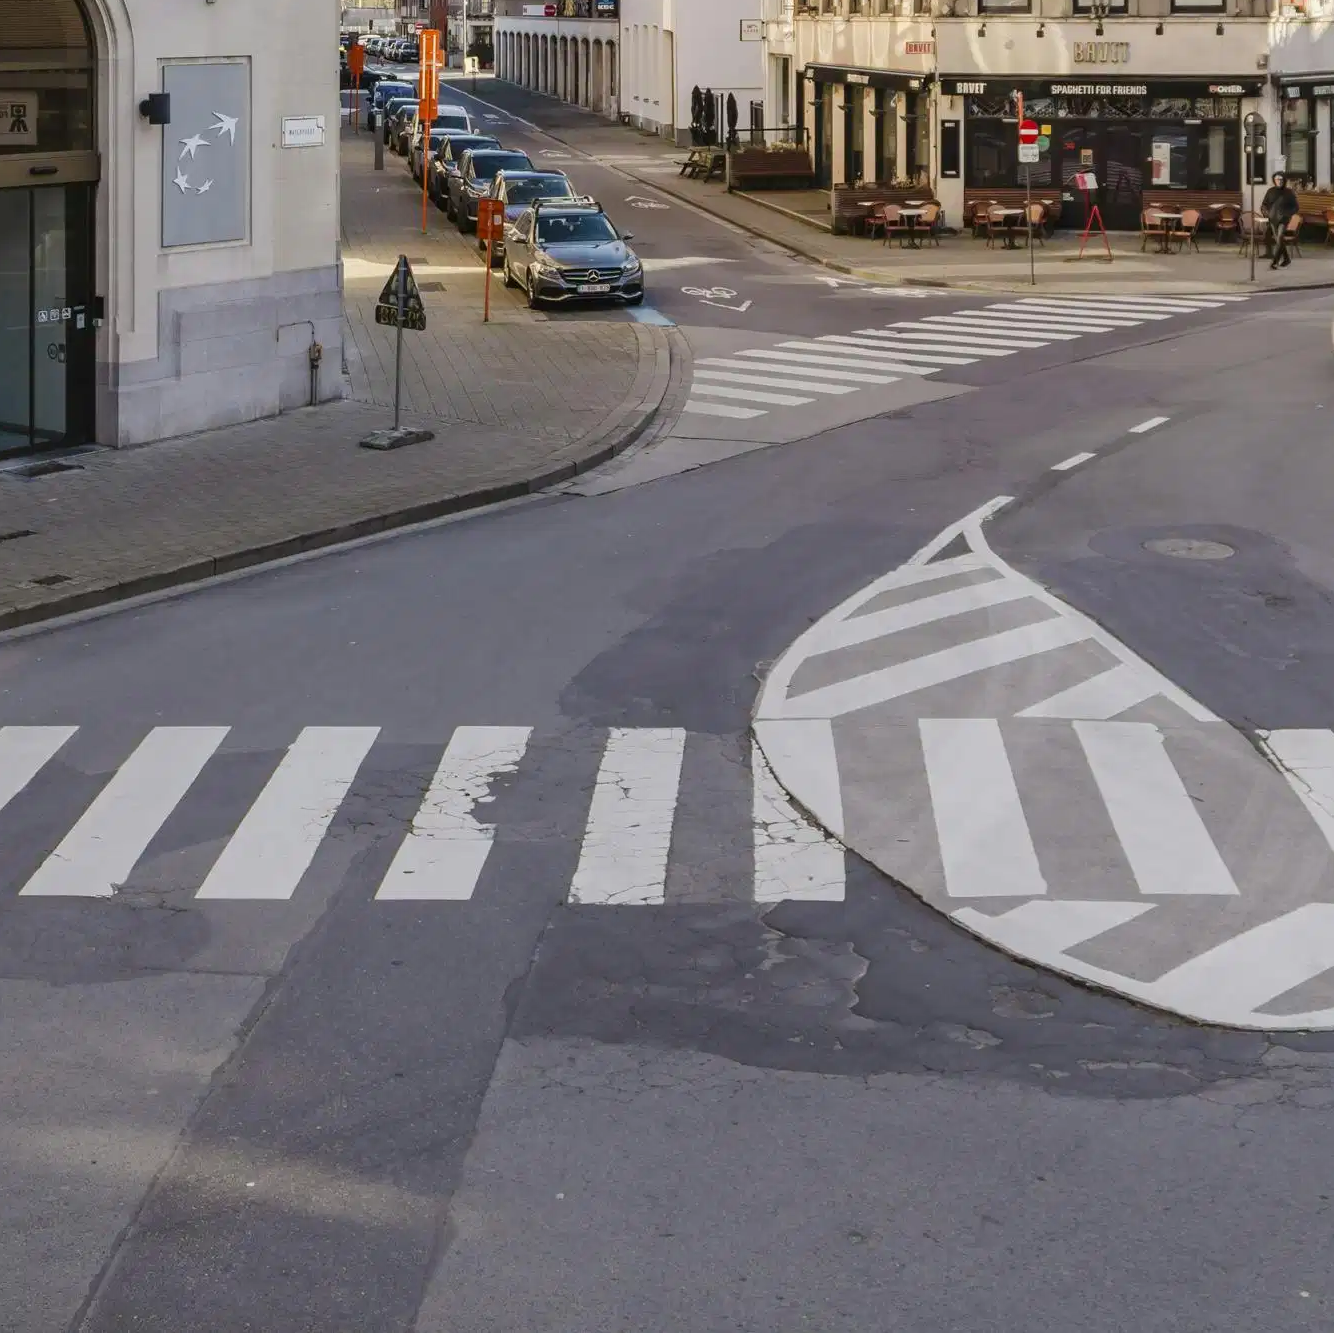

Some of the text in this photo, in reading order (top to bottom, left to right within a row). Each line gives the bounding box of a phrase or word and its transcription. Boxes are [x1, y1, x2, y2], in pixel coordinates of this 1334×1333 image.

[908, 43, 932, 53] BAVET
[1073, 41, 1131, 63] BAVET
[956, 82, 986, 95] BAVET
[1051, 84, 1147, 95] SPAGHETTI FOR FRIENDS
